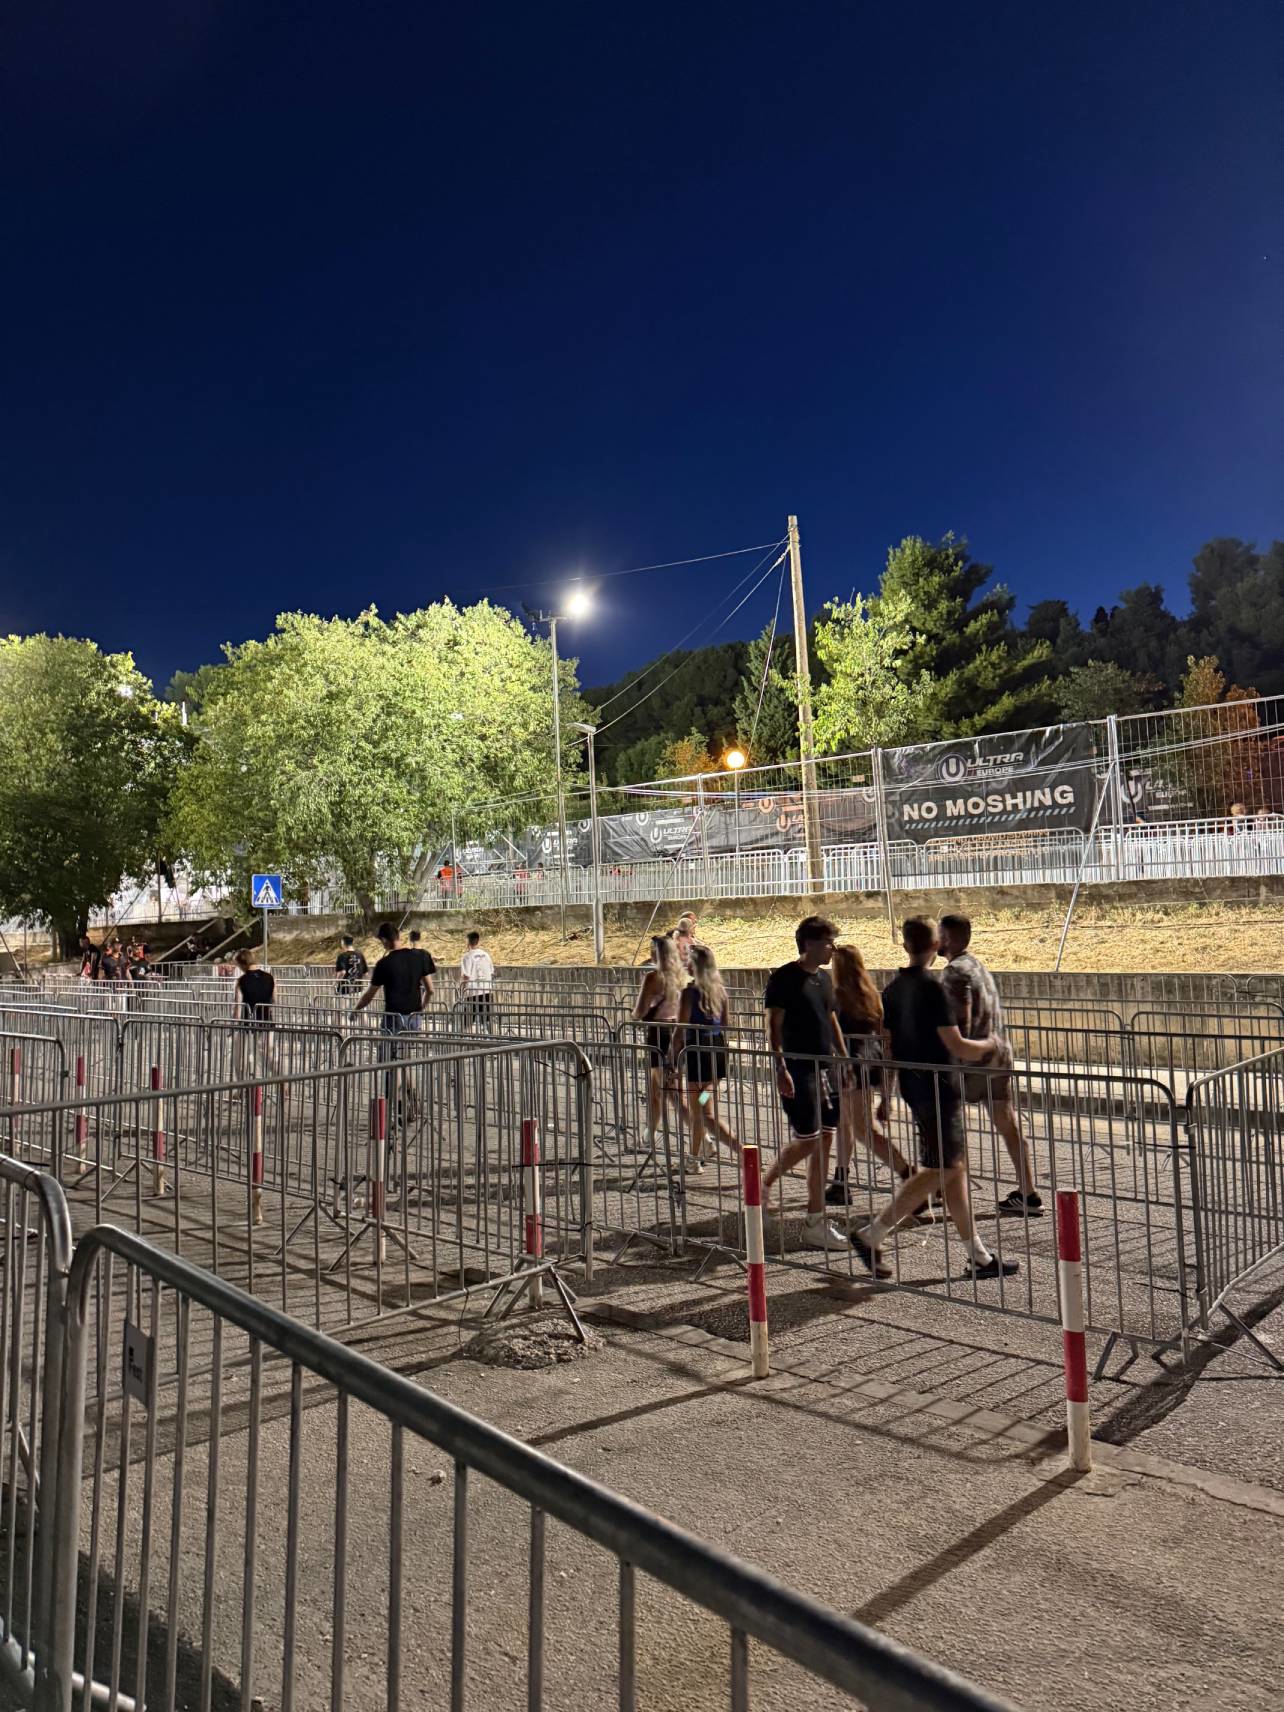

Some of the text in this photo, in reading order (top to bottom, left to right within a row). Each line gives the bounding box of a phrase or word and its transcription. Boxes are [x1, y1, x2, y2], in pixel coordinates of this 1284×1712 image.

[967, 752, 1024, 768] ULTRA
[976, 766, 1014, 778] EUROPE
[903, 785, 1075, 821] NO MOSHING
